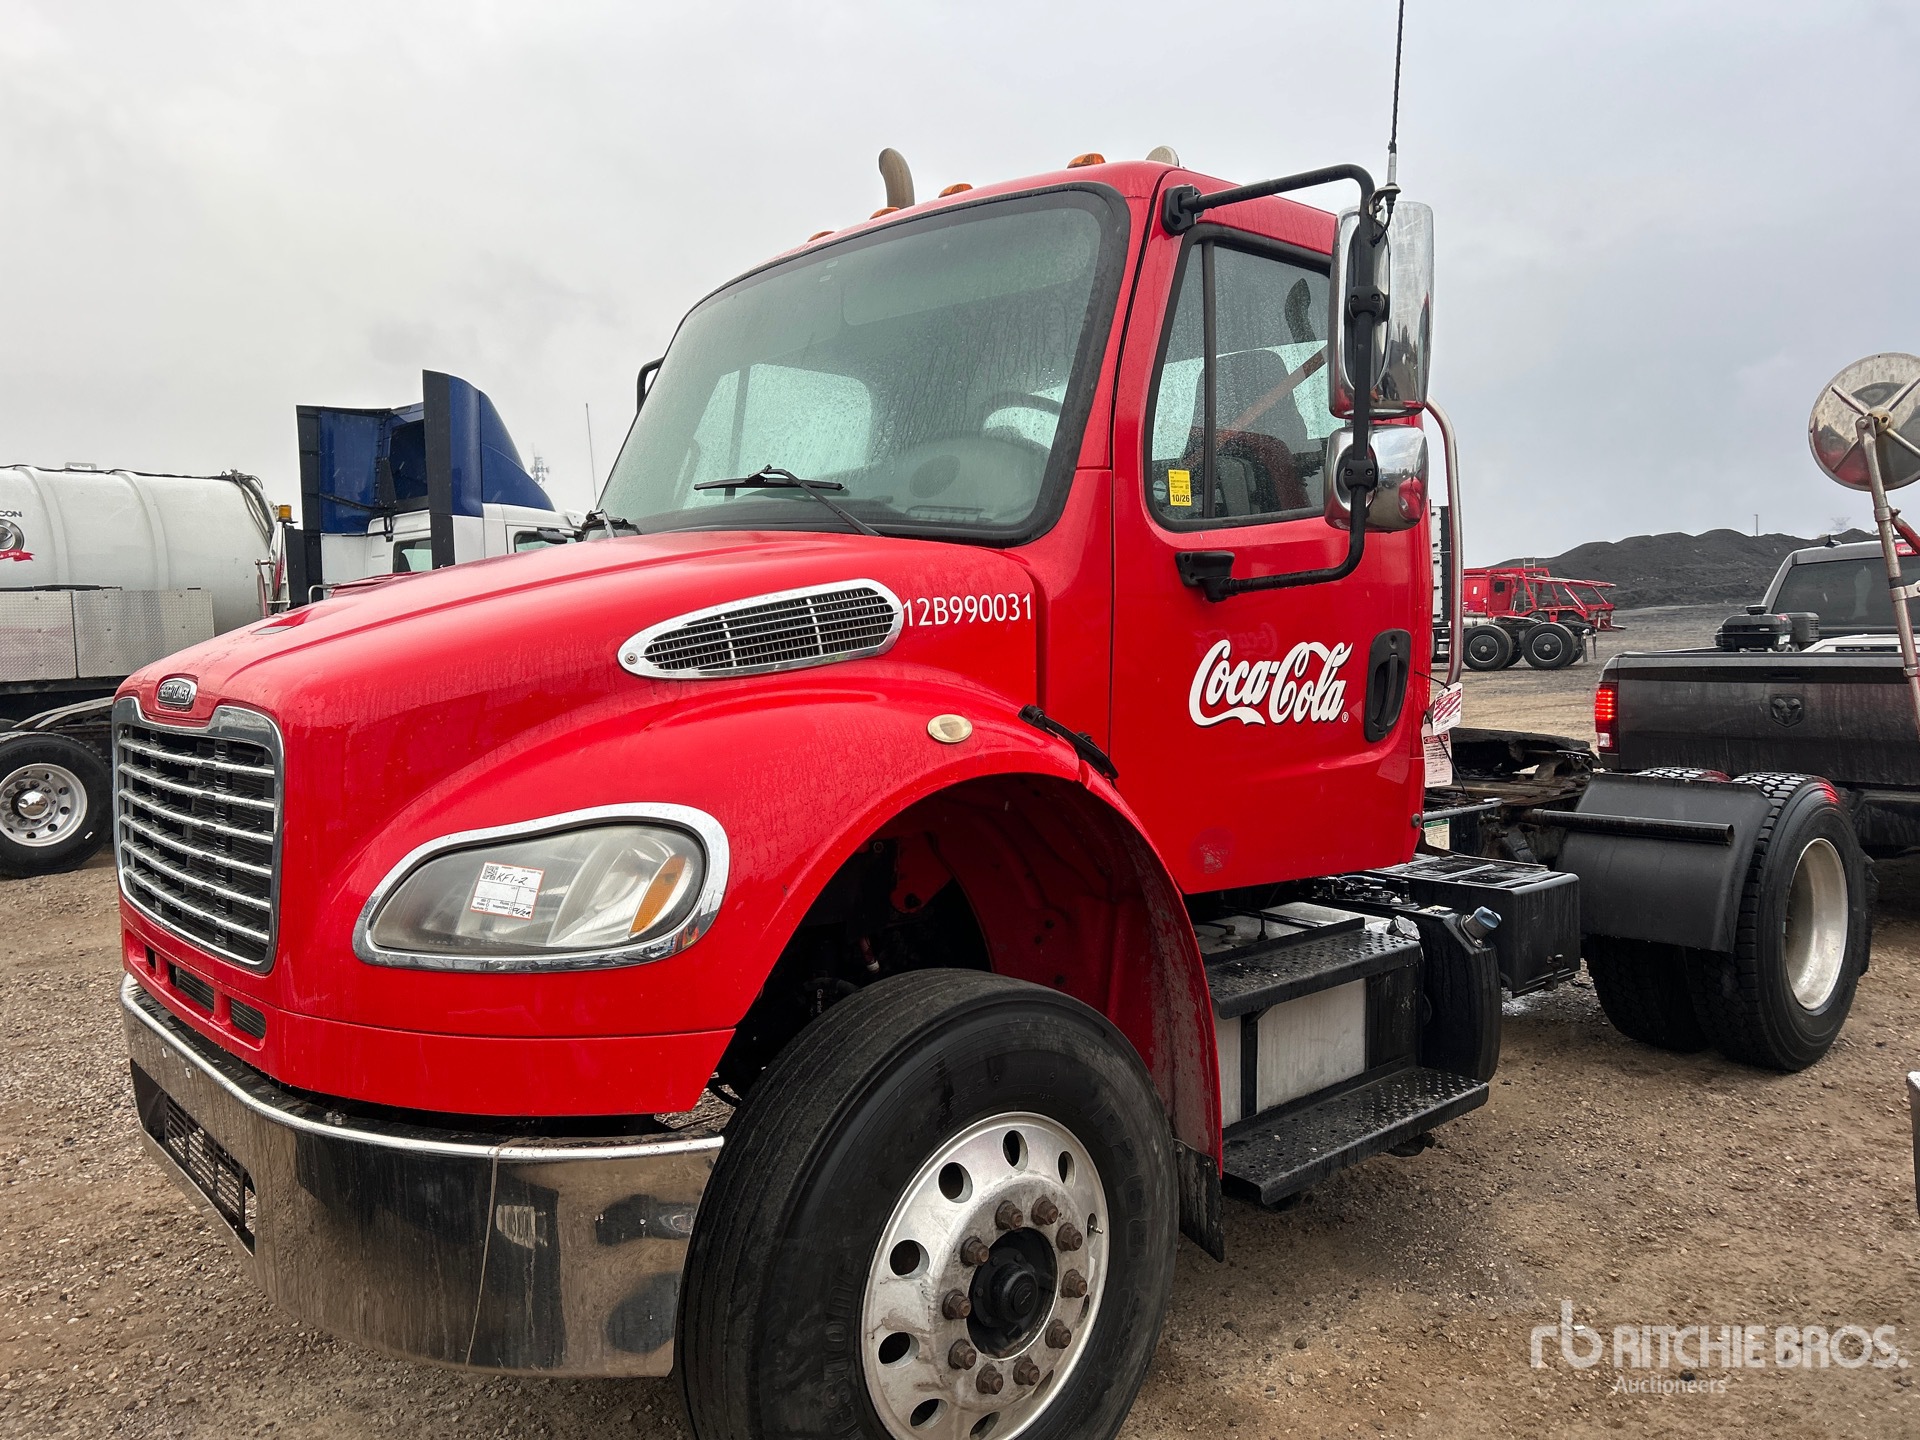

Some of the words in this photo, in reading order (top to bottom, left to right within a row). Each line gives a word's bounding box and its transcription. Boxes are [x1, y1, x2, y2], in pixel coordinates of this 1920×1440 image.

[1172, 494, 1190, 503] 10/26
[903, 592, 1032, 627] 12B990031
[1188, 639, 1353, 726] Coca-Cola
